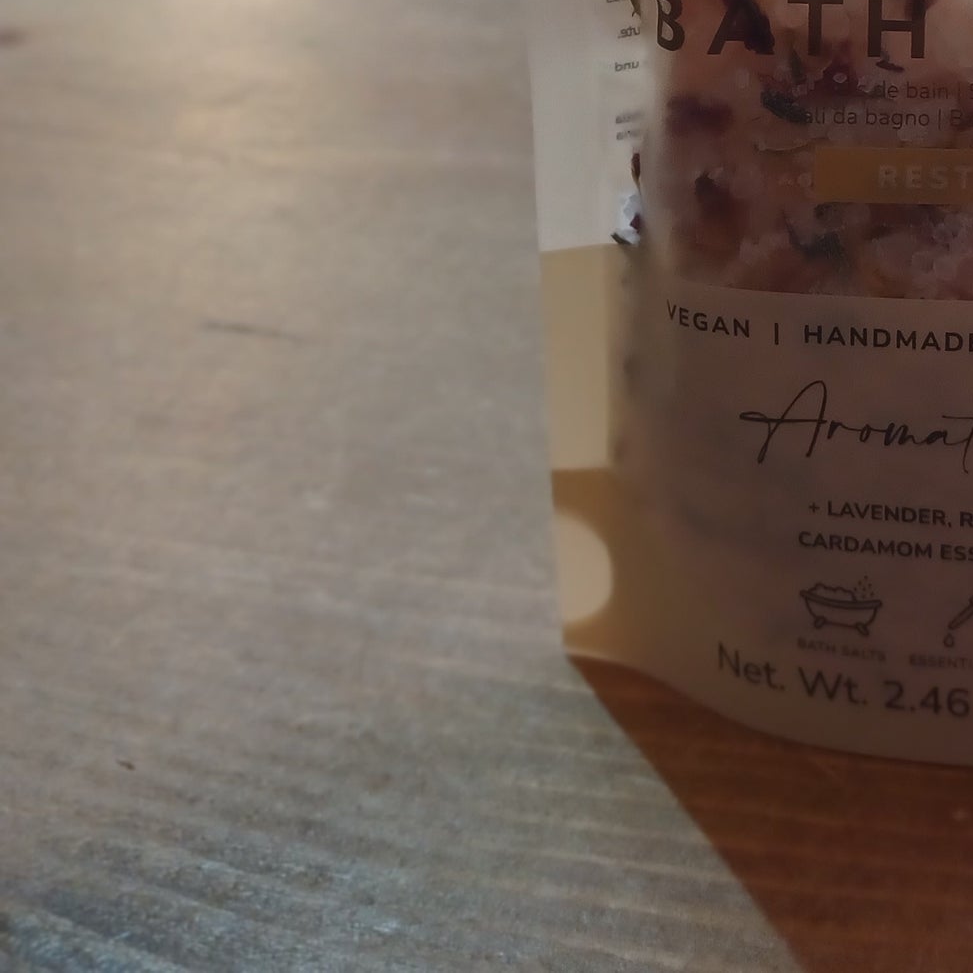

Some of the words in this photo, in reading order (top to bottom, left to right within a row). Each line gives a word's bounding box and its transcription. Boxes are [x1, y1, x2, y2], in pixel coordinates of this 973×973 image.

[906, 82, 949, 100] bain
[833, 108, 858, 126] da
[865, 109, 930, 130] bagno
[666, 299, 750, 339] VEGAN
[827, 500, 952, 527] LAVENDER,
[798, 530, 933, 559] CARDAMOM
[796, 638, 838, 656] BATH
[840, 644, 887, 662] SALTS
[717, 640, 786, 692] Net.
[797, 666, 869, 706] Wt.
[882, 679, 971, 717] 2.46
